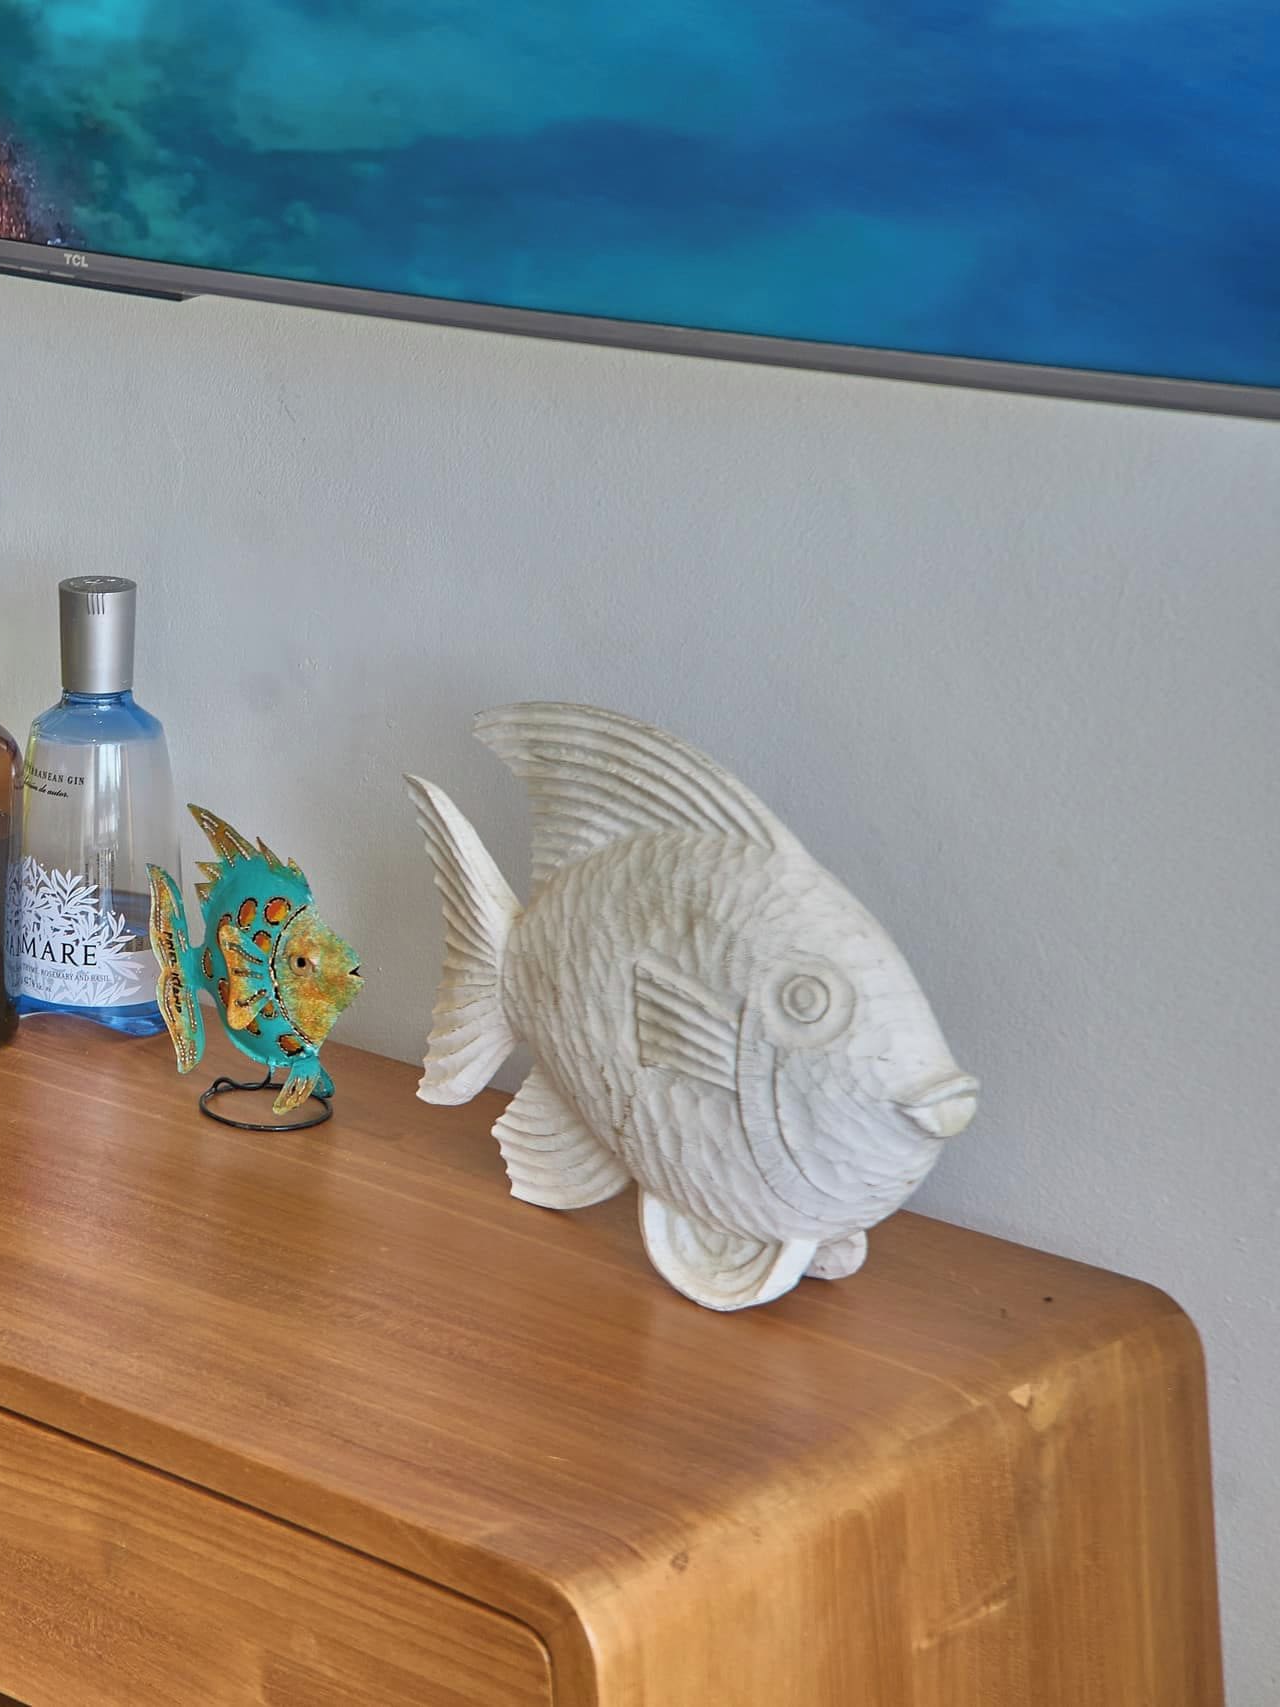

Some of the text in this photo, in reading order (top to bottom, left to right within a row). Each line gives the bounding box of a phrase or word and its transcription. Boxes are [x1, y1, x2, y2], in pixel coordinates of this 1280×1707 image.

[63, 252, 89, 268] TCL
[66, 775, 86, 786] GIN
[20, 934, 98, 967] MARE
